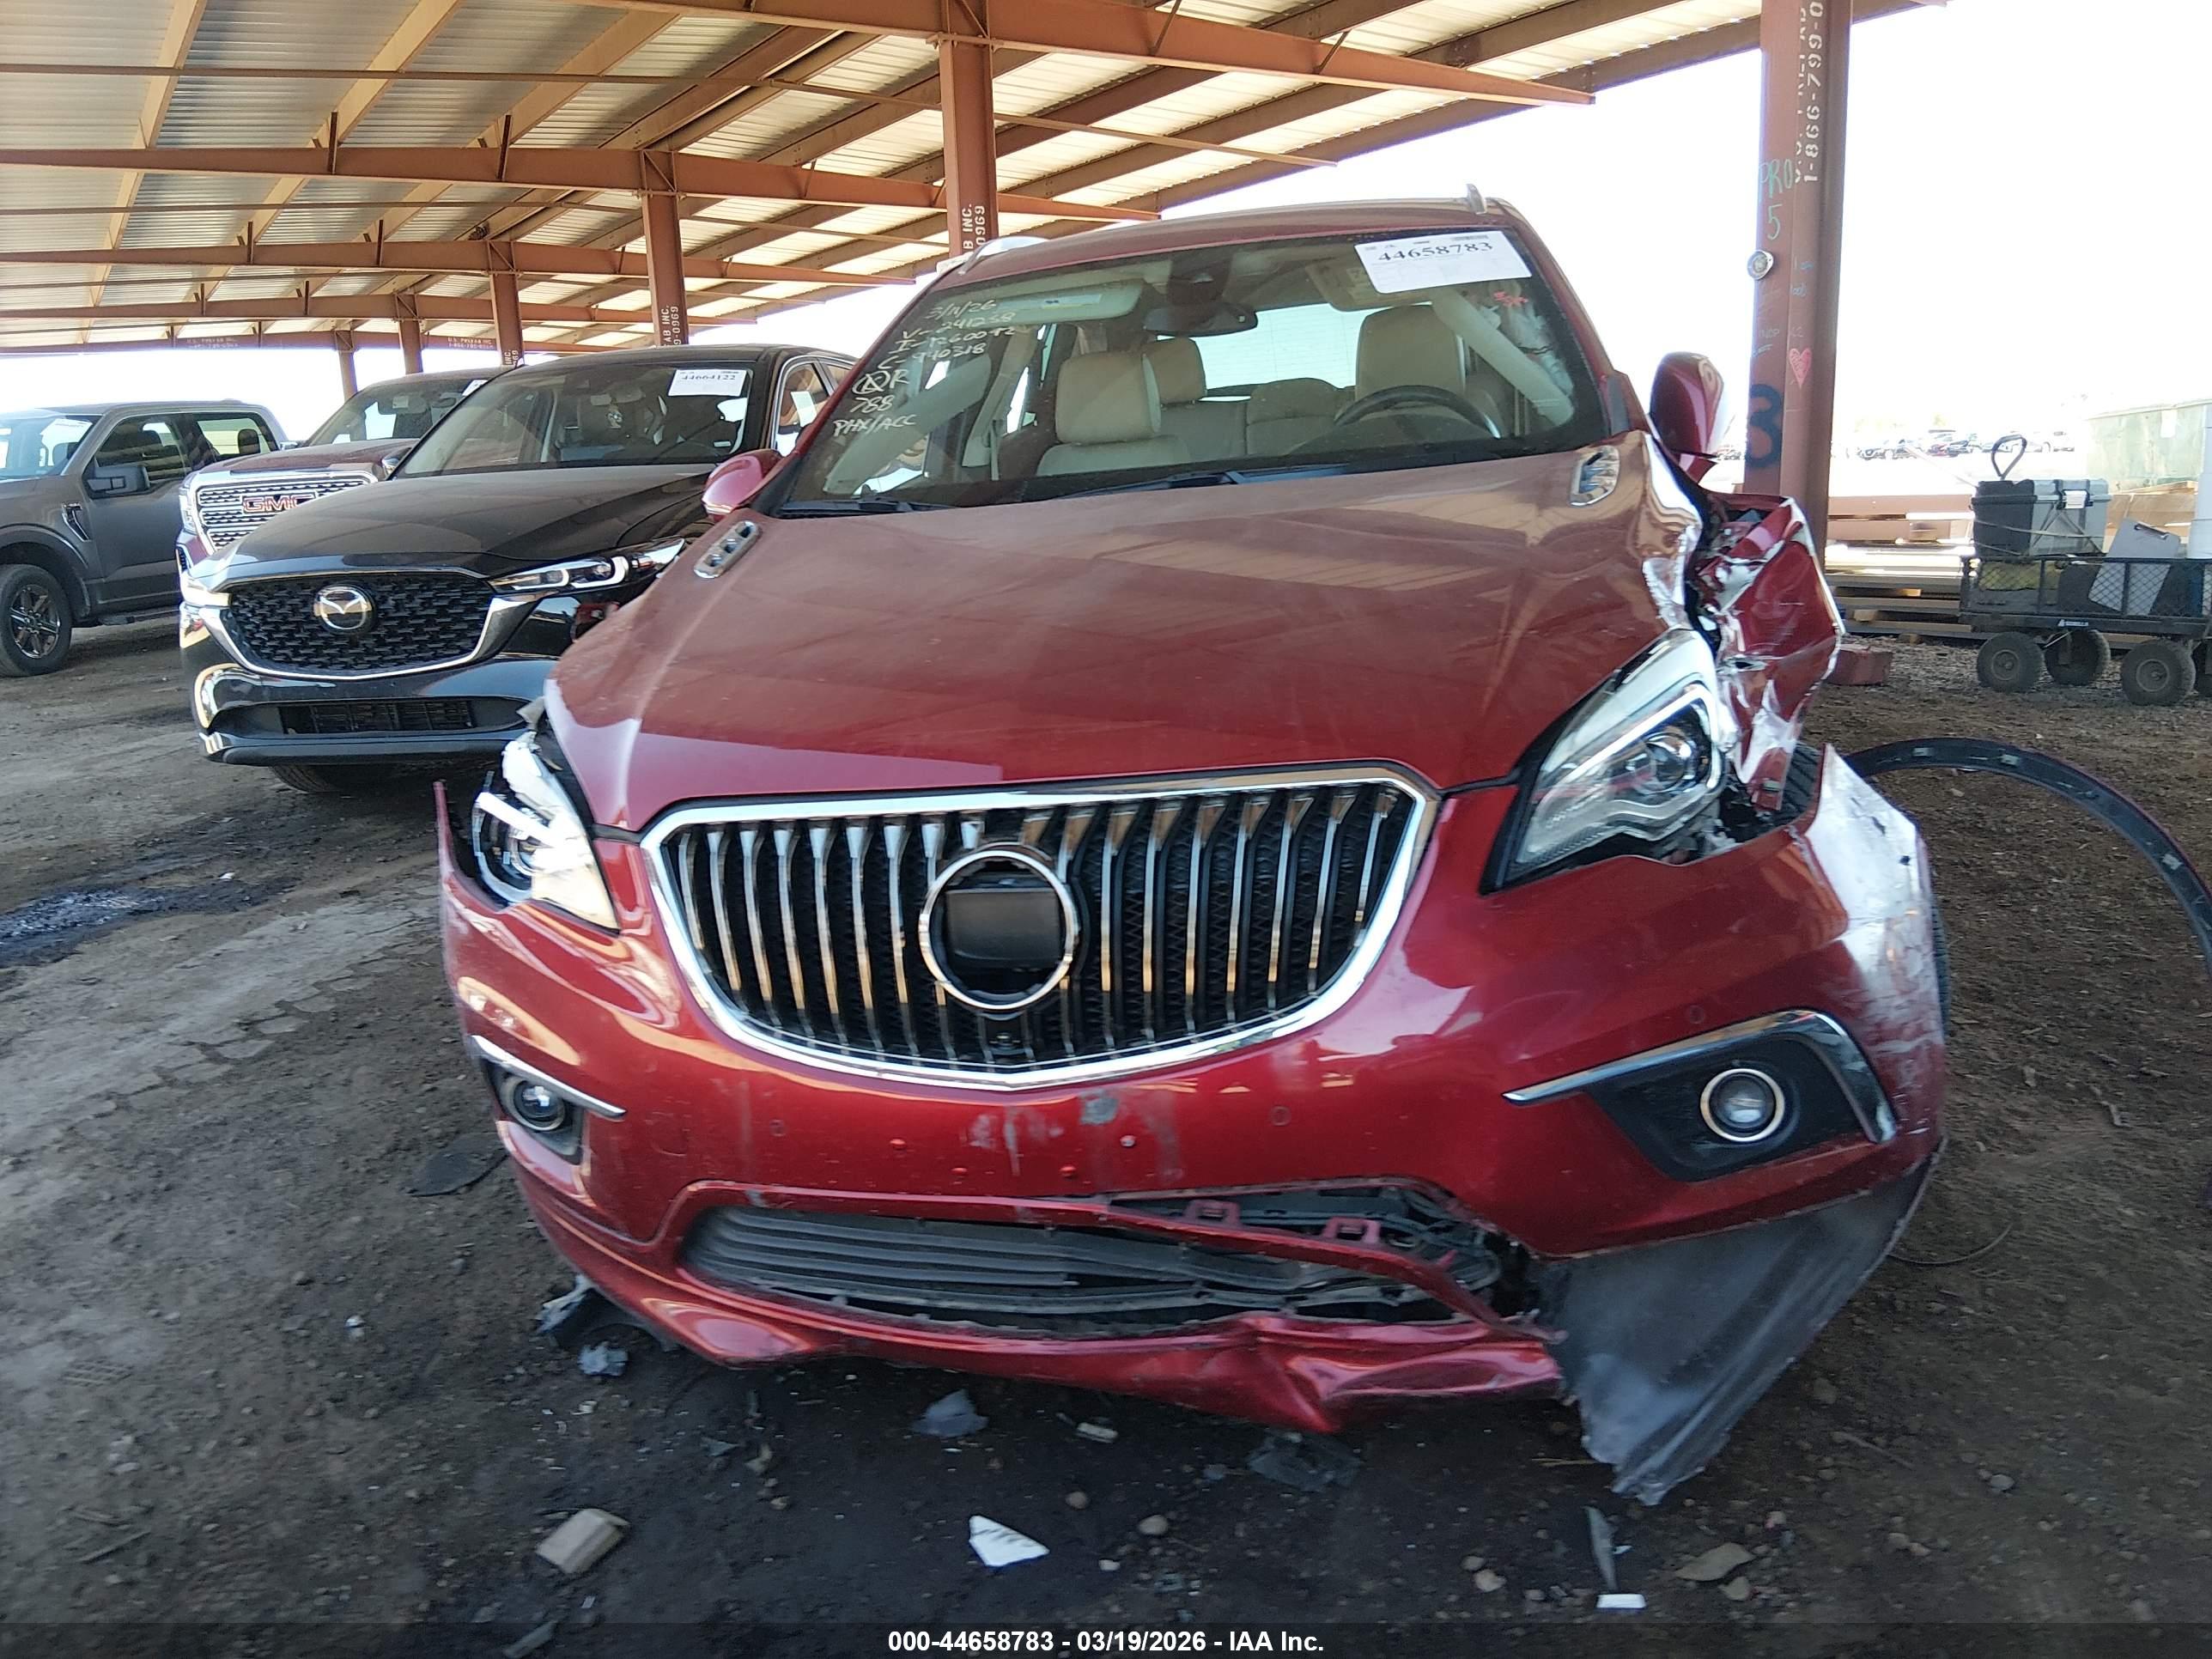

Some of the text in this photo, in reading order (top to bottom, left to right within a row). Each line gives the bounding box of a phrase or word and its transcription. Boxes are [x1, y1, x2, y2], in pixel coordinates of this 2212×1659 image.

[962, 204, 973, 233] INC.
[974, 205, 986, 246] 0969
[1767, 203, 1784, 240] 5
[1378, 241, 1493, 262] 44658783
[660, 305, 671, 325] INC.
[850, 394, 895, 413] 788
[243, 493, 315, 514] GMC
